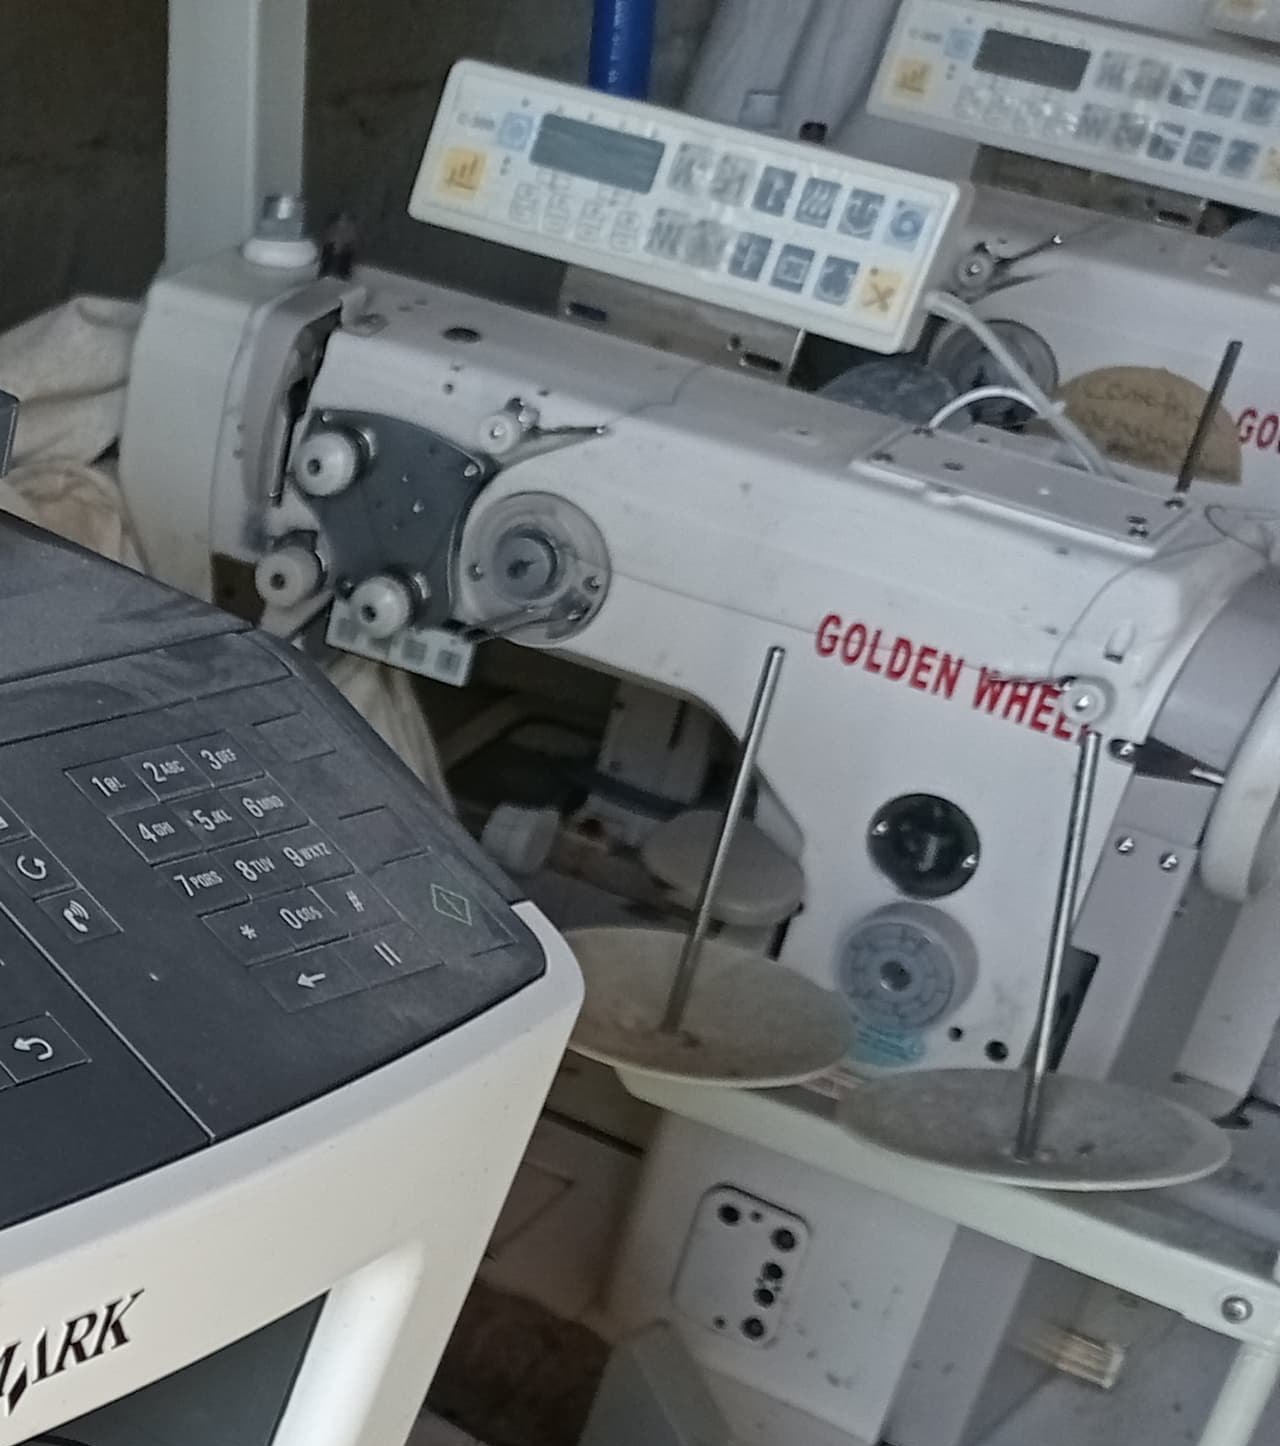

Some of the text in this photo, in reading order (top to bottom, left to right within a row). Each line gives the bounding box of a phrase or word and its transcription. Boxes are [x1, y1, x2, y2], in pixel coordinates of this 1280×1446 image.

[1236, 407, 1280, 454] GO
[815, 613, 1091, 745] GOLDEN WHE
